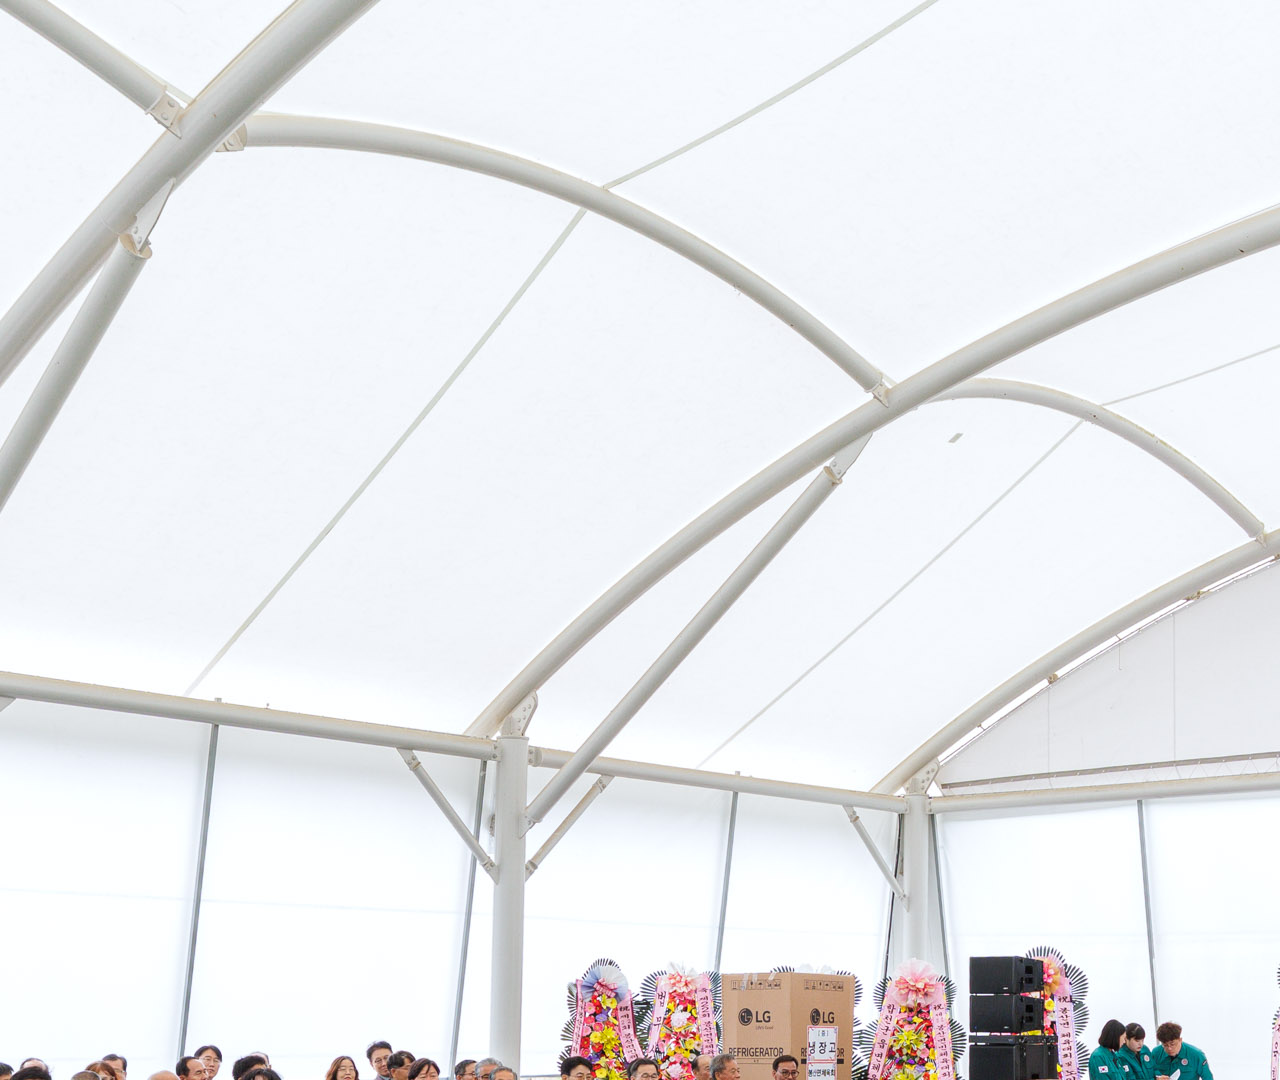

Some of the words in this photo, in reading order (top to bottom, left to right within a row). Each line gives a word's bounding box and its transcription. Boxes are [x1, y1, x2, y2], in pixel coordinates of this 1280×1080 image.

[755, 1010, 771, 1023] LG
[822, 1011, 835, 1024] LG
[808, 1041, 836, 1055] 냉장고
